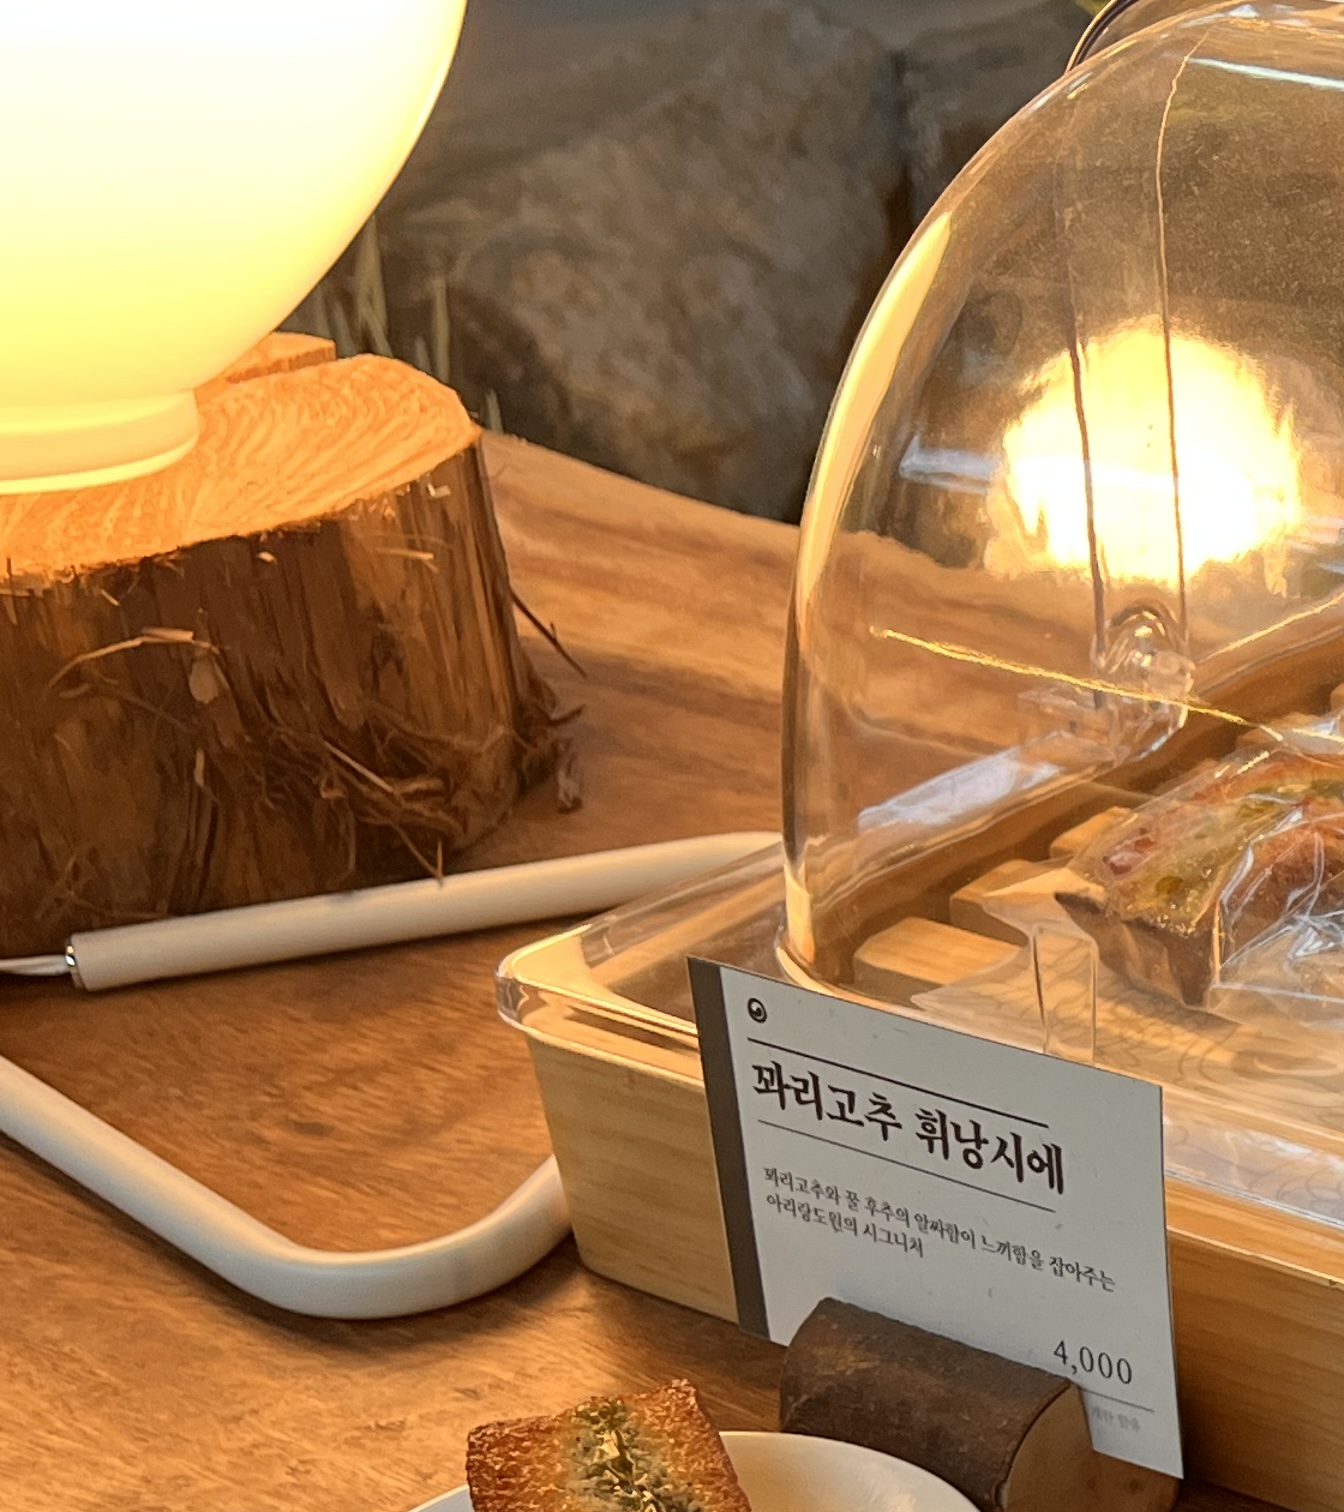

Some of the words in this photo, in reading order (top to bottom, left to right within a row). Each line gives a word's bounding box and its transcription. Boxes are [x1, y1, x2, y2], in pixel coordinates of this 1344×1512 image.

[752, 1061, 902, 1141] 꽈리고추
[915, 1108, 1064, 1195] 휘낭시에
[764, 1167, 839, 1206] 꽈리고추와
[982, 1235, 1045, 1272] 느끼함을
[1050, 1256, 1115, 1293] 잡아주는
[766, 1193, 858, 1237] 아리랑도원의
[1053, 1340, 1132, 1385] 4,000
